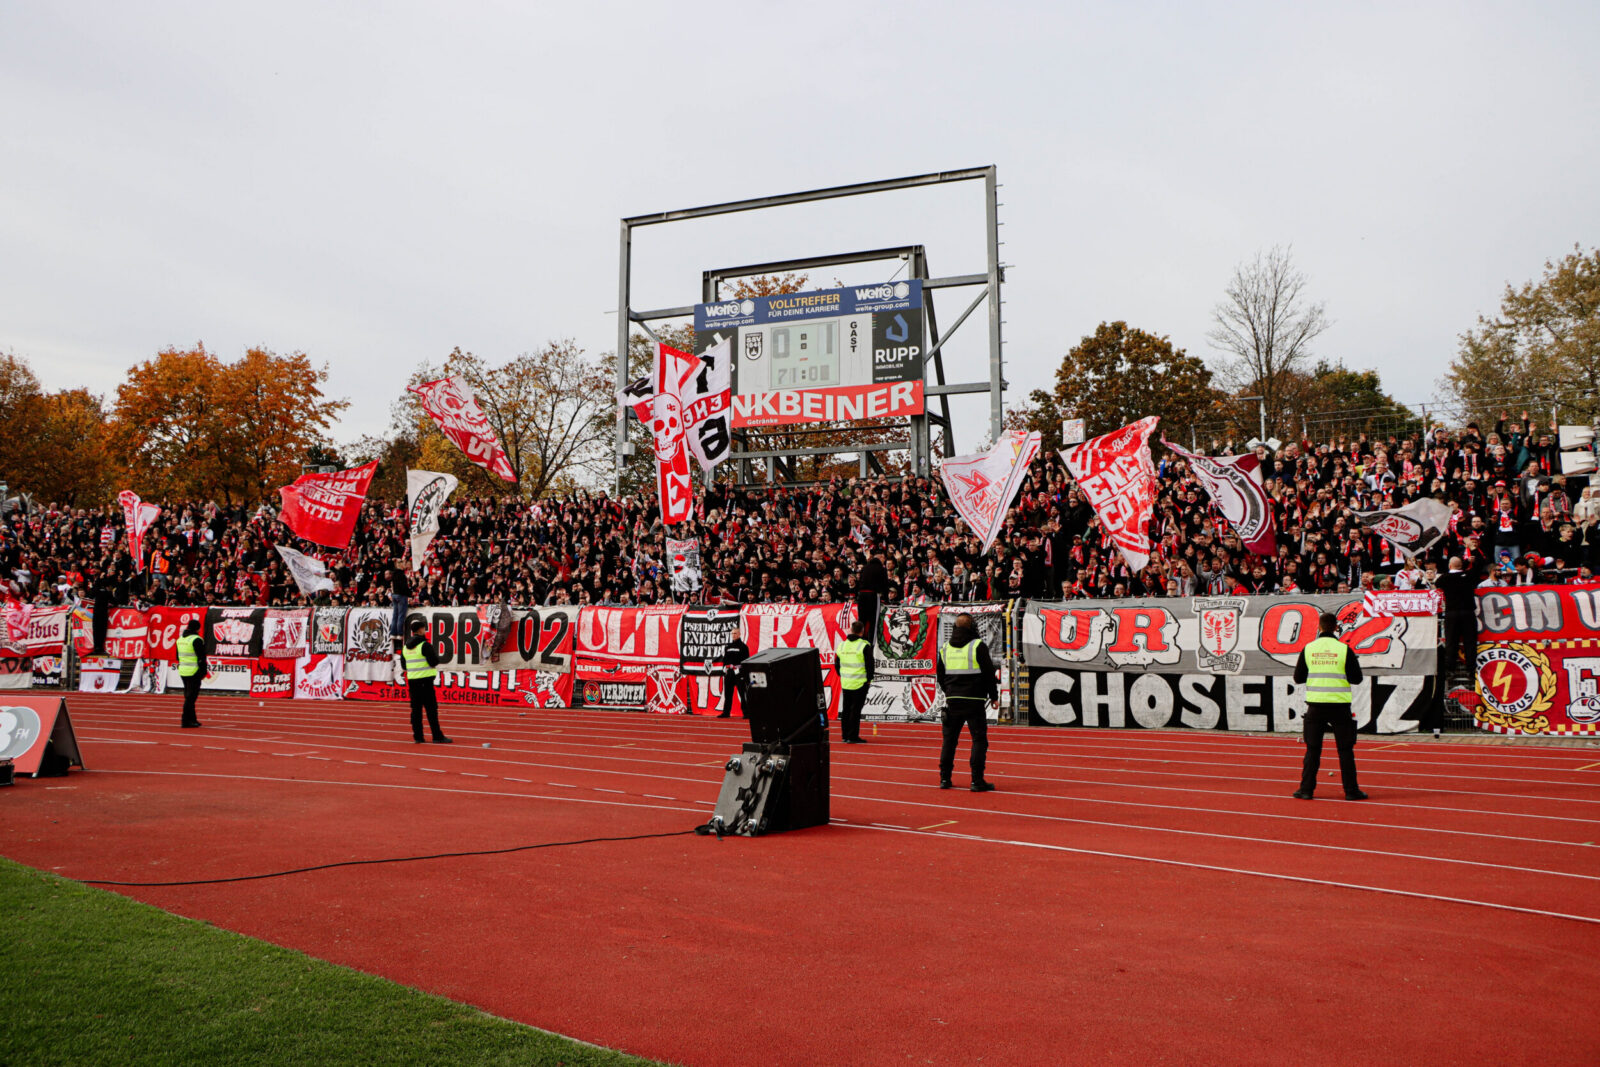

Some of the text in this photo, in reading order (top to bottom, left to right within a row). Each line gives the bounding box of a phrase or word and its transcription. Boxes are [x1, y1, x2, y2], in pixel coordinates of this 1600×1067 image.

[768, 293, 840, 310] VOLLTREFFER
[768, 303, 840, 318] FÜR DEINE KARRIERE
[875, 346, 920, 363] RUPP
[731, 381, 914, 421] NKBEINER
[1373, 599, 1433, 613] KEVIN
[518, 610, 569, 667] 02
[684, 631, 733, 645] ENERGI
[683, 645, 726, 658] COTTB
[622, 665, 646, 673] FRONT
[379, 688, 501, 704] STIRB SICHERHEIT
[15, 728, 30, 739] FM
